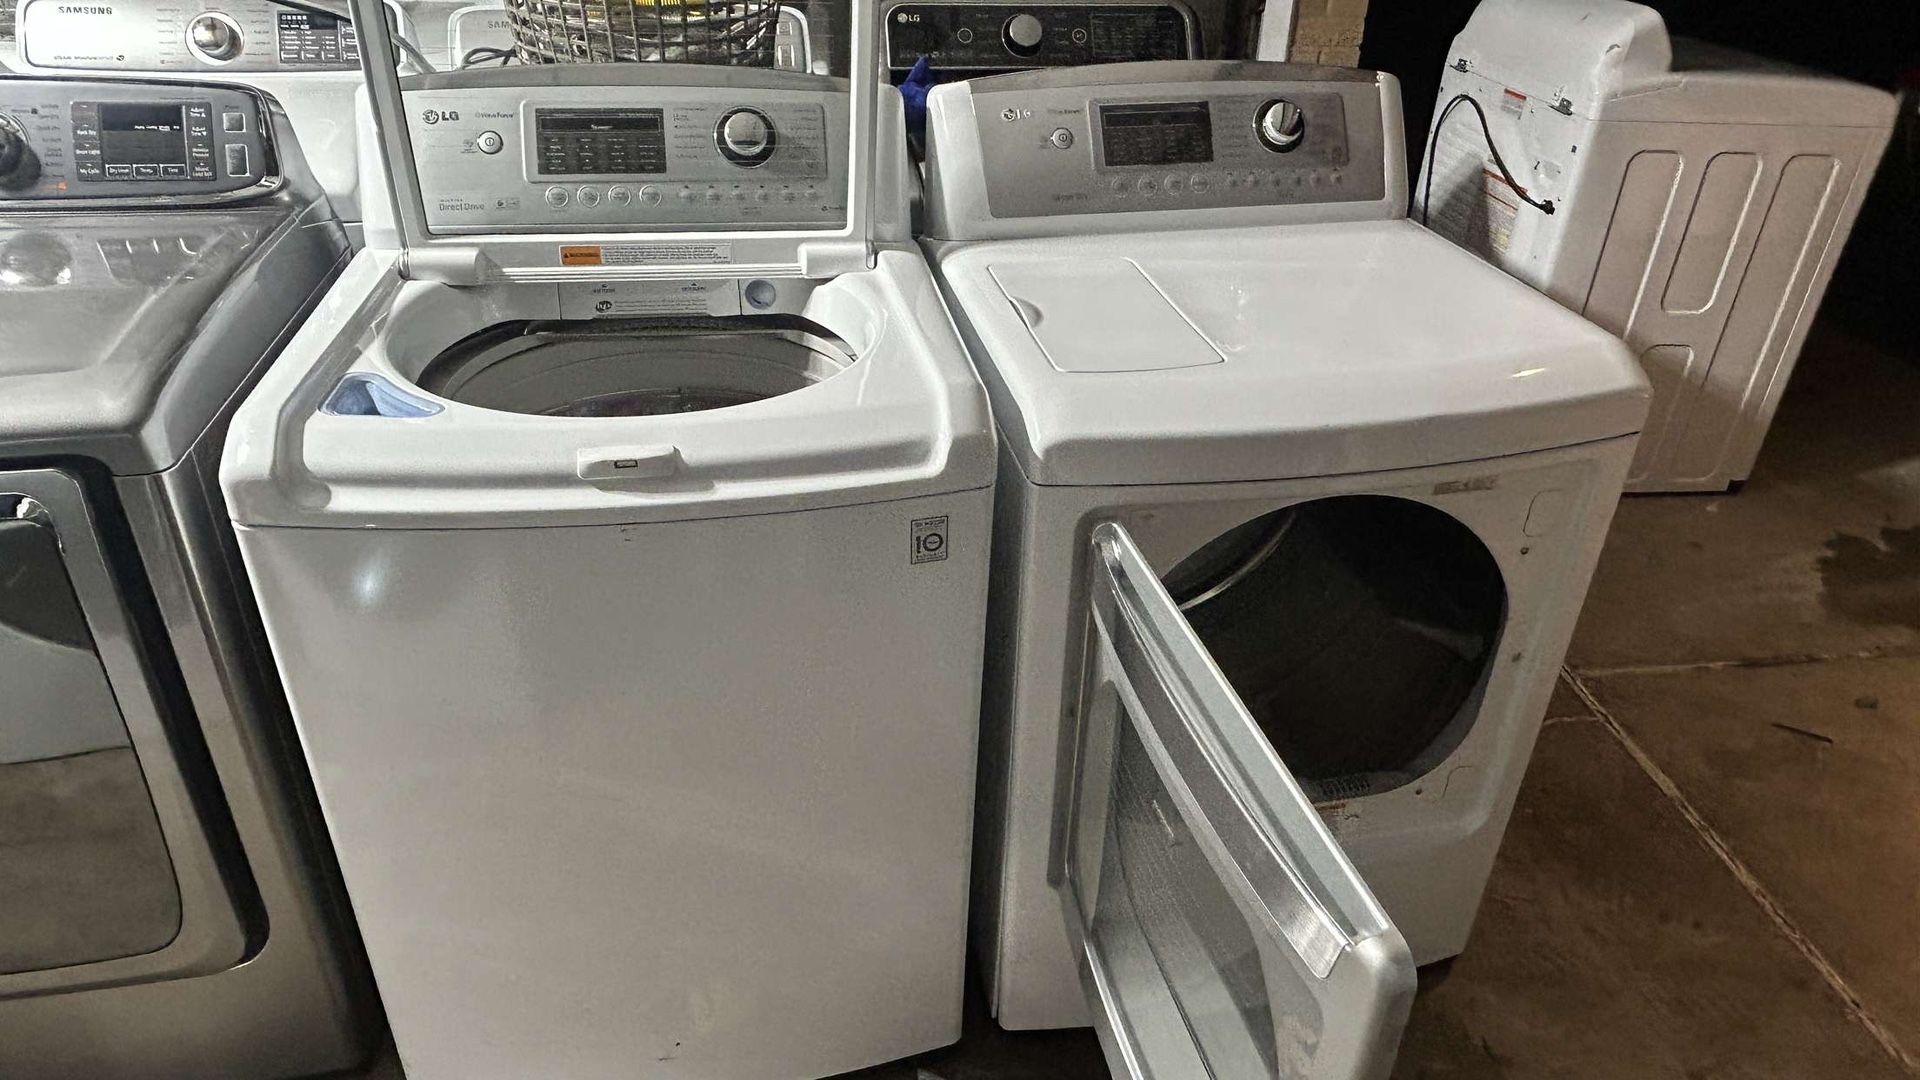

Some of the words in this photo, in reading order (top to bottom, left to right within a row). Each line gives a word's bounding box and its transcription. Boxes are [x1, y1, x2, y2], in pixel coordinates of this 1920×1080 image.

[58, 6, 113, 15] SAMSUNG
[908, 14, 920, 22] LG
[441, 110, 460, 121] LG
[1016, 109, 1031, 119] LG
[439, 203, 463, 211] Direct
[464, 202, 485, 210] Drive
